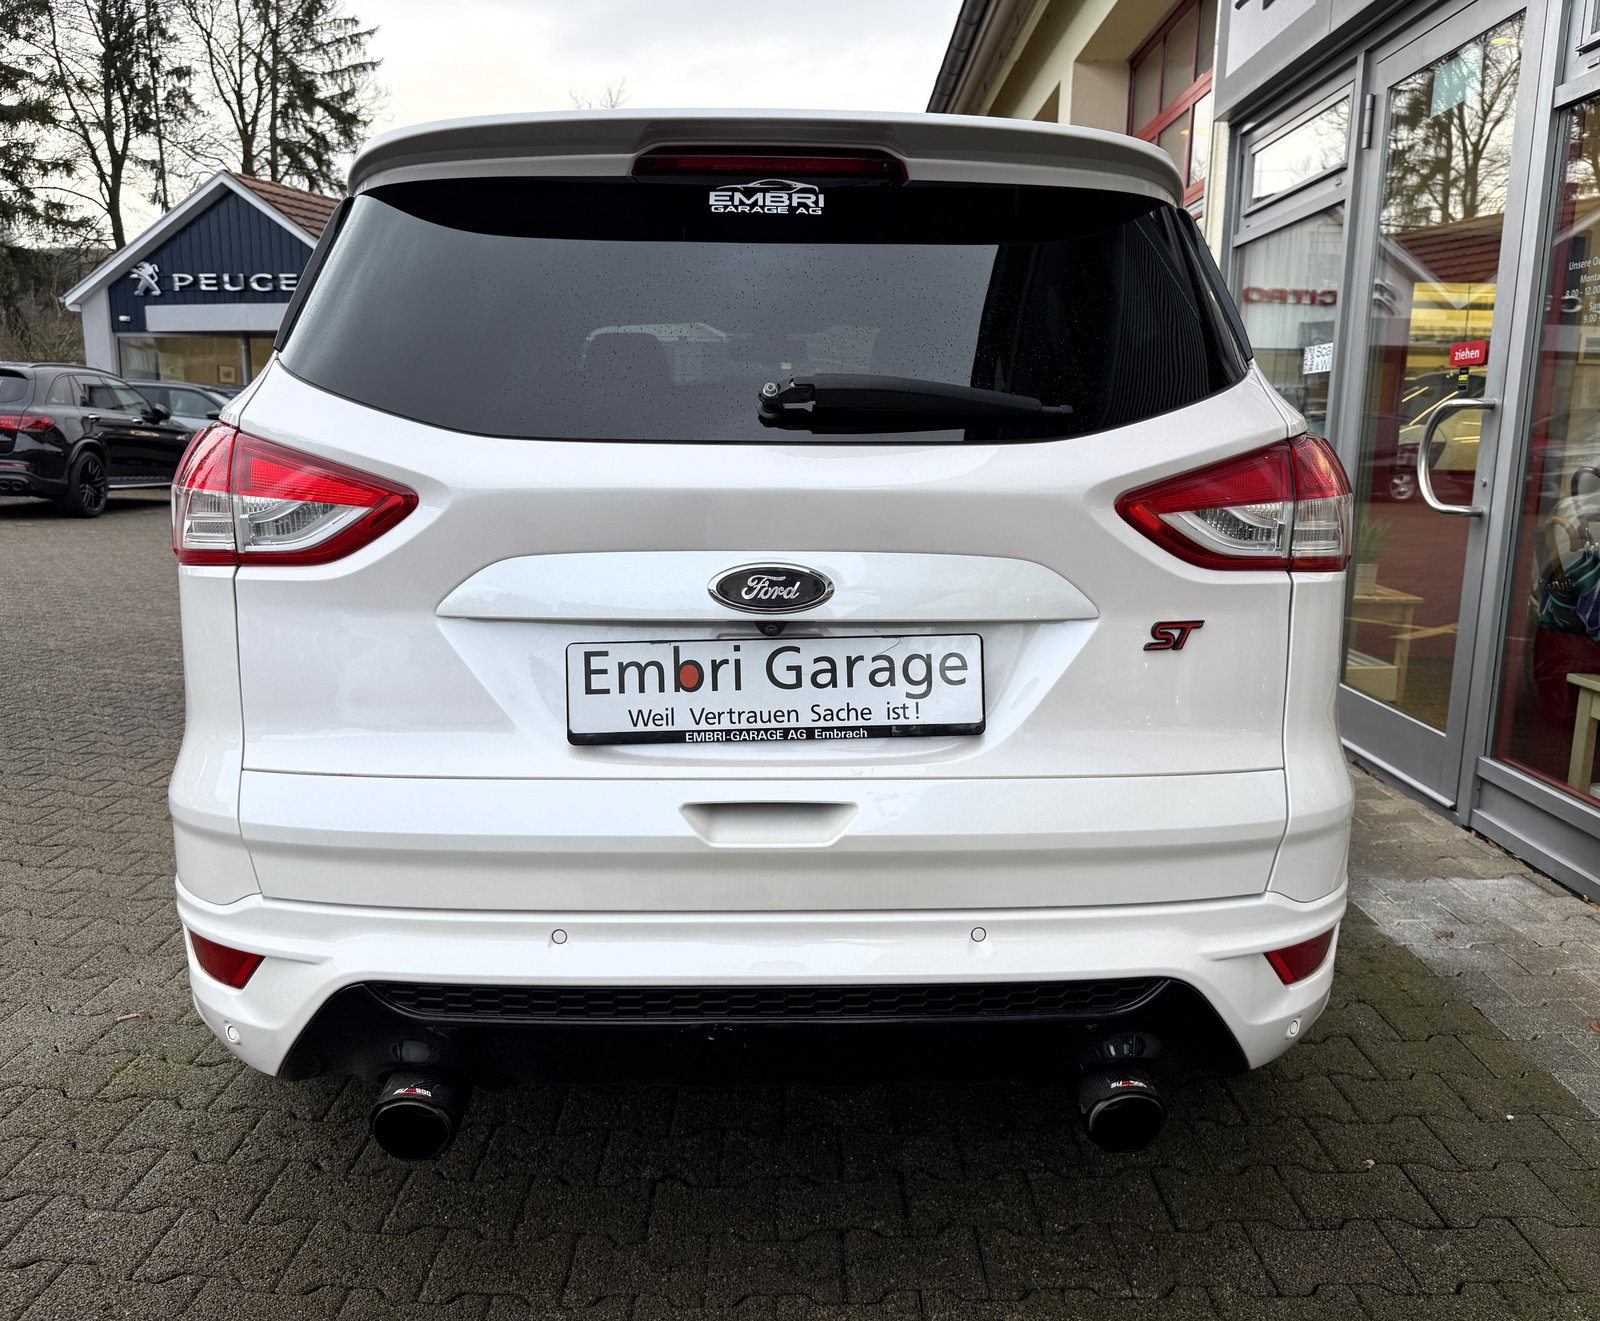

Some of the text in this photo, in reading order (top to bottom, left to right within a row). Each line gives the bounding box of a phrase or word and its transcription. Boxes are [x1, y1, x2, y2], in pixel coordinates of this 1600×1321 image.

[709, 191, 824, 207] EMBRI
[711, 205, 822, 215] GARAGE AG
[1569, 260, 1592, 271] Unsere
[1454, 347, 1480, 361] ziehen
[741, 574, 801, 600] Ford
[1143, 620, 1205, 651] ST
[584, 645, 968, 699] Embri Garage
[628, 707, 675, 727] Weil
[689, 706, 800, 726] Vertrauen
[810, 702, 873, 722] Sache
[685, 728, 868, 742] EMBRI-GARAGE AG Embrach
